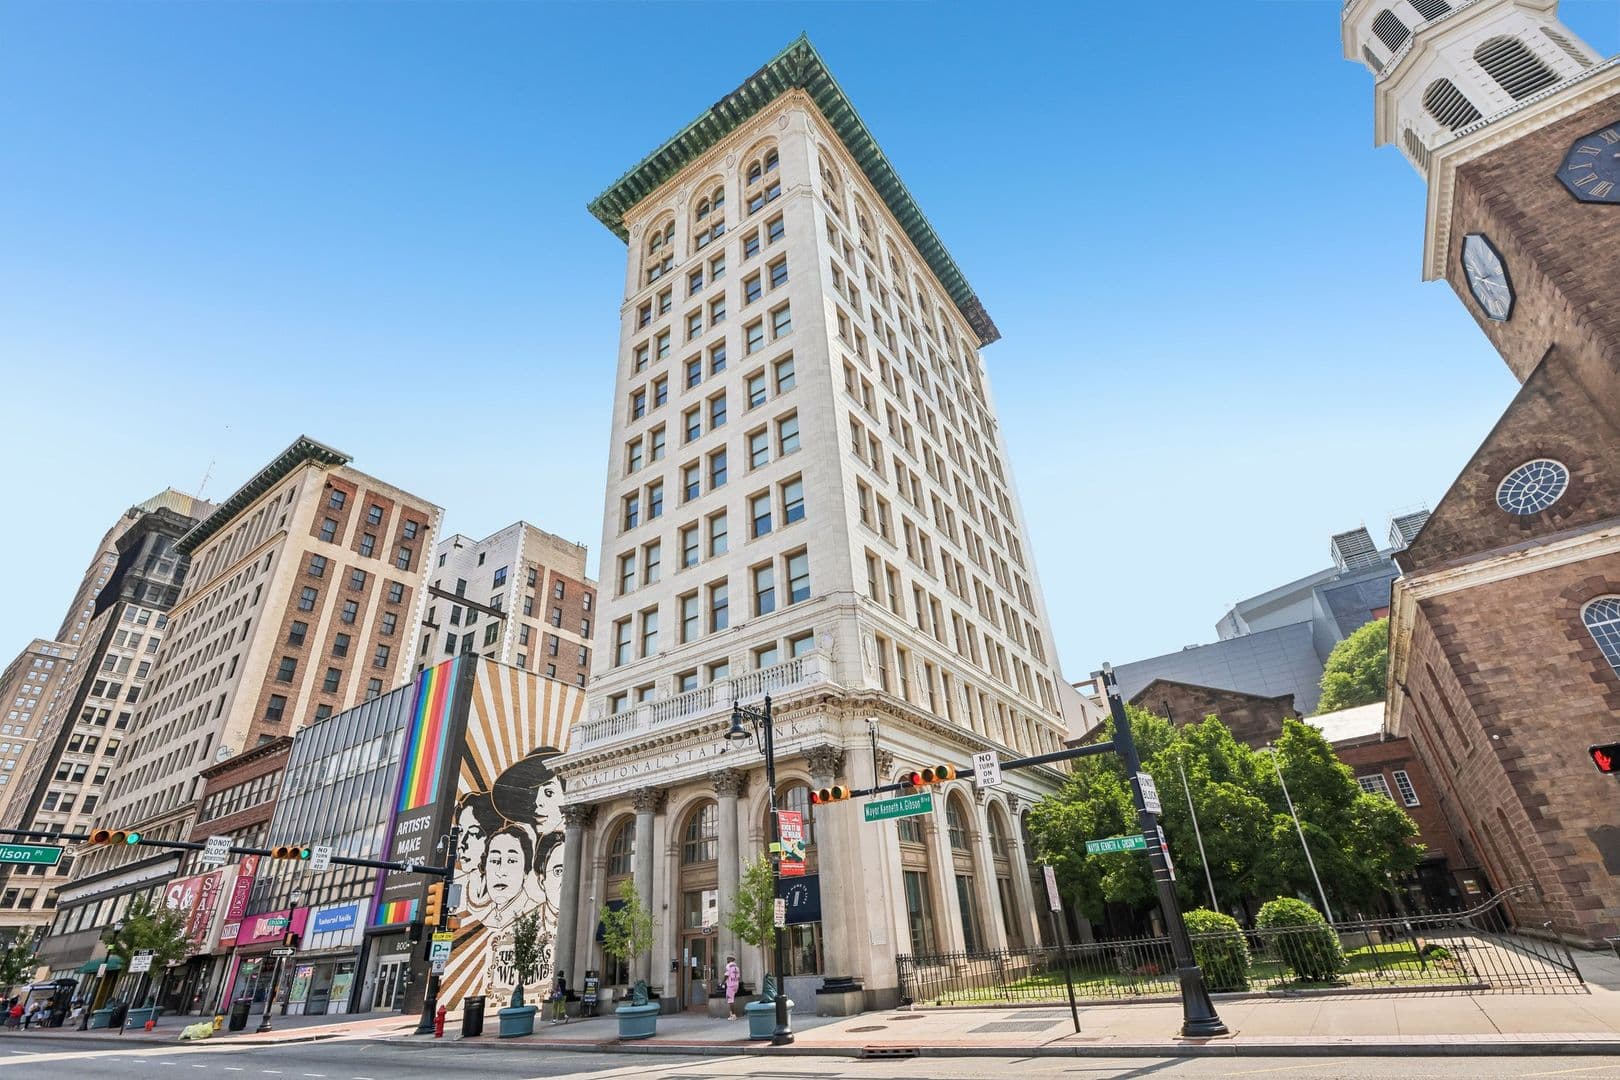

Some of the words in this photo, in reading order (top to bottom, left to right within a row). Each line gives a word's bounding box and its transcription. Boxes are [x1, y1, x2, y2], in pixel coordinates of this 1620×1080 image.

[580, 758, 661, 786] NATIONAL
[674, 740, 731, 764] STATE
[747, 724, 801, 746] BNK
[979, 754, 991, 762] NO
[865, 806, 880, 818] Mayor
[880, 803, 899, 814] Kenneth
[900, 802, 905, 811] A.
[905, 800, 920, 810] Gibson
[396, 815, 431, 836] ARTISTS
[206, 847, 227, 855] BLOCK
[217, 839, 230, 847] NOT
[396, 837, 422, 855] MAKE
[388, 856, 425, 876] TRES
[432, 944, 442, 957] P
[497, 965, 515, 986] WE
